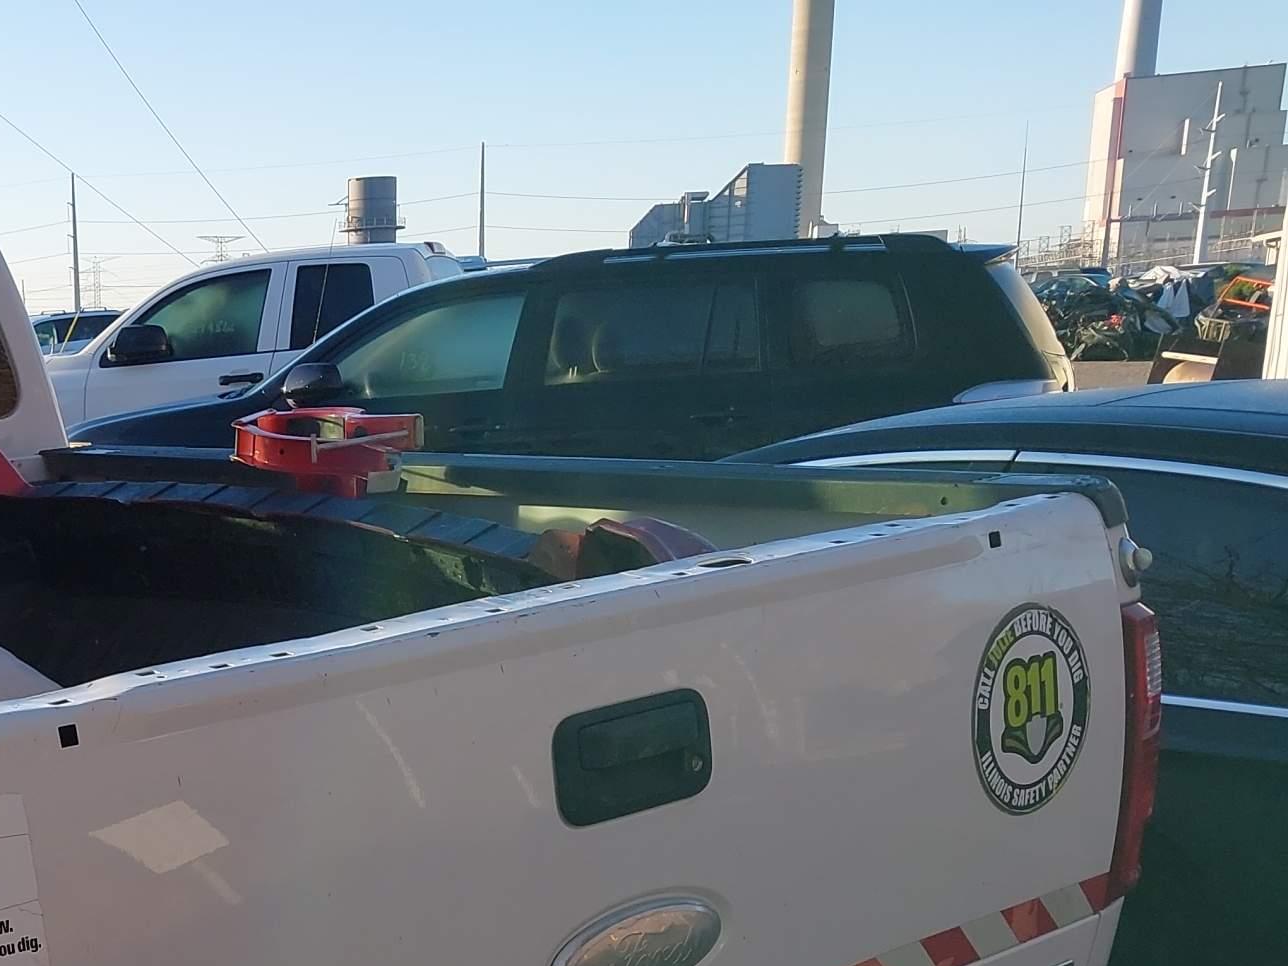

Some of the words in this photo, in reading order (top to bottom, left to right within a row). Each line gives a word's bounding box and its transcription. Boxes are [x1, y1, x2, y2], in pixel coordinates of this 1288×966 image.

[978, 667, 995, 710] CALL
[1014, 610, 1053, 635] BEFORE
[1052, 621, 1073, 655] YOU
[1068, 652, 1083, 684] DIG
[1005, 654, 1057, 728] 811
[981, 751, 1012, 804] ILLINOIS
[1012, 783, 1046, 807] SAFETY
[1047, 724, 1082, 792] PARTNER
[17, 936, 42, 954] dig.
